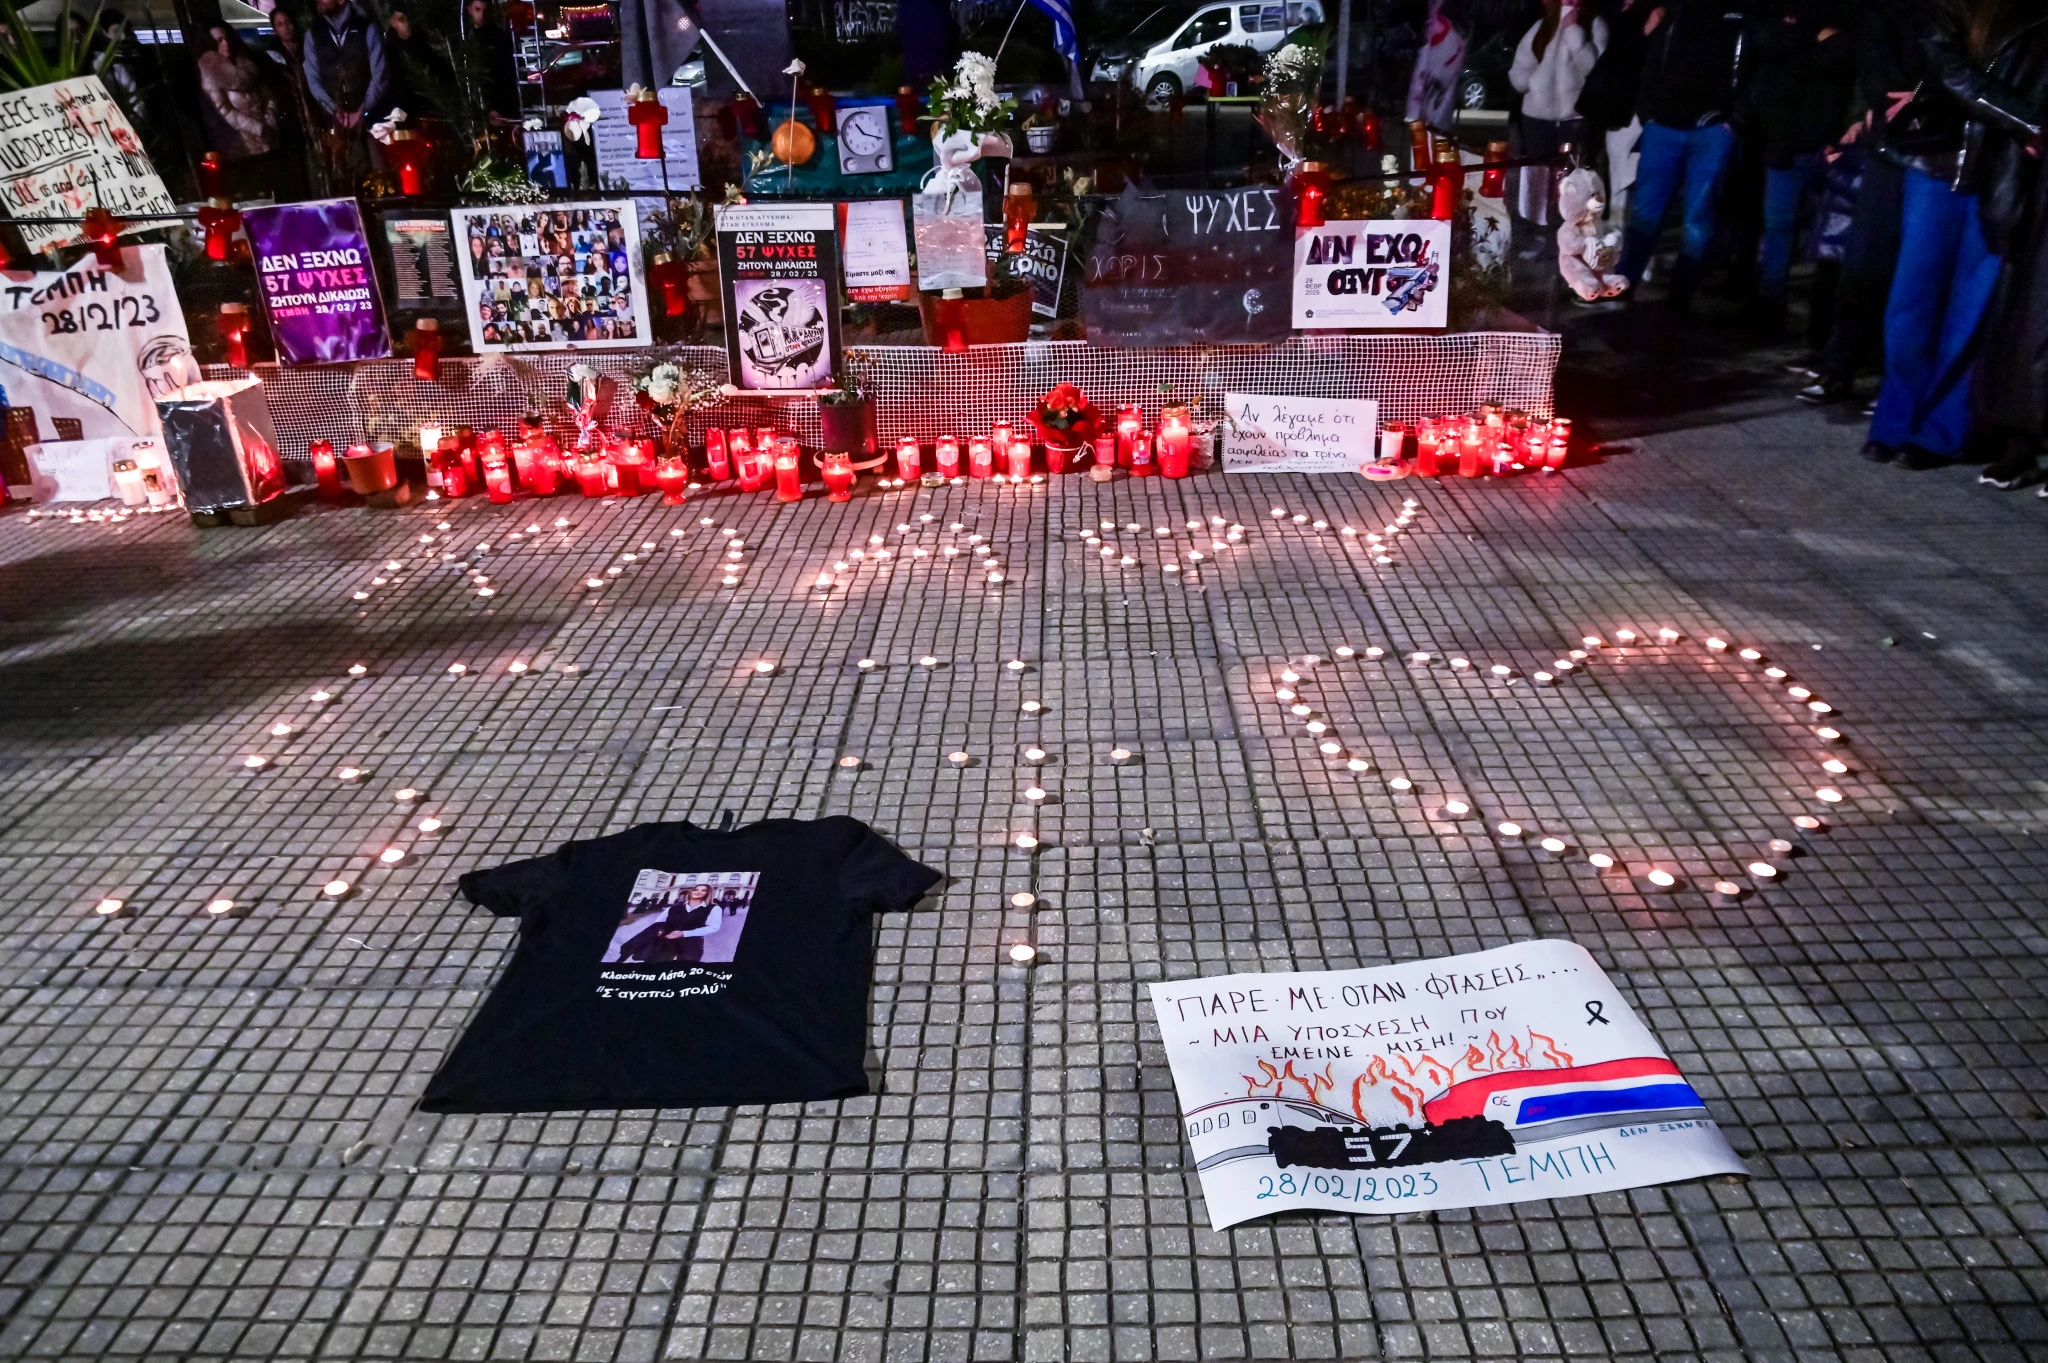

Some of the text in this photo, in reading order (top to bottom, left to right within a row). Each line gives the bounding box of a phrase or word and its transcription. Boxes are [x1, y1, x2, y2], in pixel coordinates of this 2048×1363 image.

[40, 103, 54, 118] is
[0, 182, 40, 210] KILL
[102, 155, 116, 179] it
[1186, 189, 1280, 234] ΨΥΧΕΣ
[736, 231, 815, 244] ΔΕΝ ΞΕΧΝΩ
[1306, 233, 1423, 265] ΔΕΝ ΕΧΩ
[262, 248, 362, 272] ΔΕΝ ΞΕΧΝΩ
[736, 246, 816, 258] 57 ΨΥΧΕΣ
[738, 261, 817, 270] ΖΗΤΟΥΝ ΔΙΚΑΙΩΣΗ
[265, 267, 368, 292] 57 ΨΥΧΕΣ
[861, 286, 873, 294] έχω
[270, 288, 371, 307] ΖΗΤΟΥΝ ΔΙΚΑΙΩΣΗ
[41, 294, 161, 335] 28/2/23
[272, 307, 310, 318] ΤΕΜΠΗ
[1240, 403, 1355, 430] Αν λέγαμε ότι
[1275, 426, 1340, 447] πρόβλημα
[1226, 444, 1347, 461] ασφαλείας τα τρένα
[600, 967, 733, 981] Κλαούντια Λάτα, 20 ετών
[1288, 986, 1328, 1012] ΜΕ
[1342, 981, 1407, 1007] ΟΤΑΝ
[1213, 1006, 1507, 1047] ΜΙΑ ΥΠΟΣΧΕΣΗ ΠΟΥ
[1271, 1032, 1455, 1060] ΕΜΕΙΝΕ ΜΙΣΗ!
[1619, 1125, 1649, 1138] ΔΕΝ
[1344, 1132, 1413, 1163] 57
[1256, 1142, 1617, 1202] 28/02/2023 ΤΕΜΠΗ
